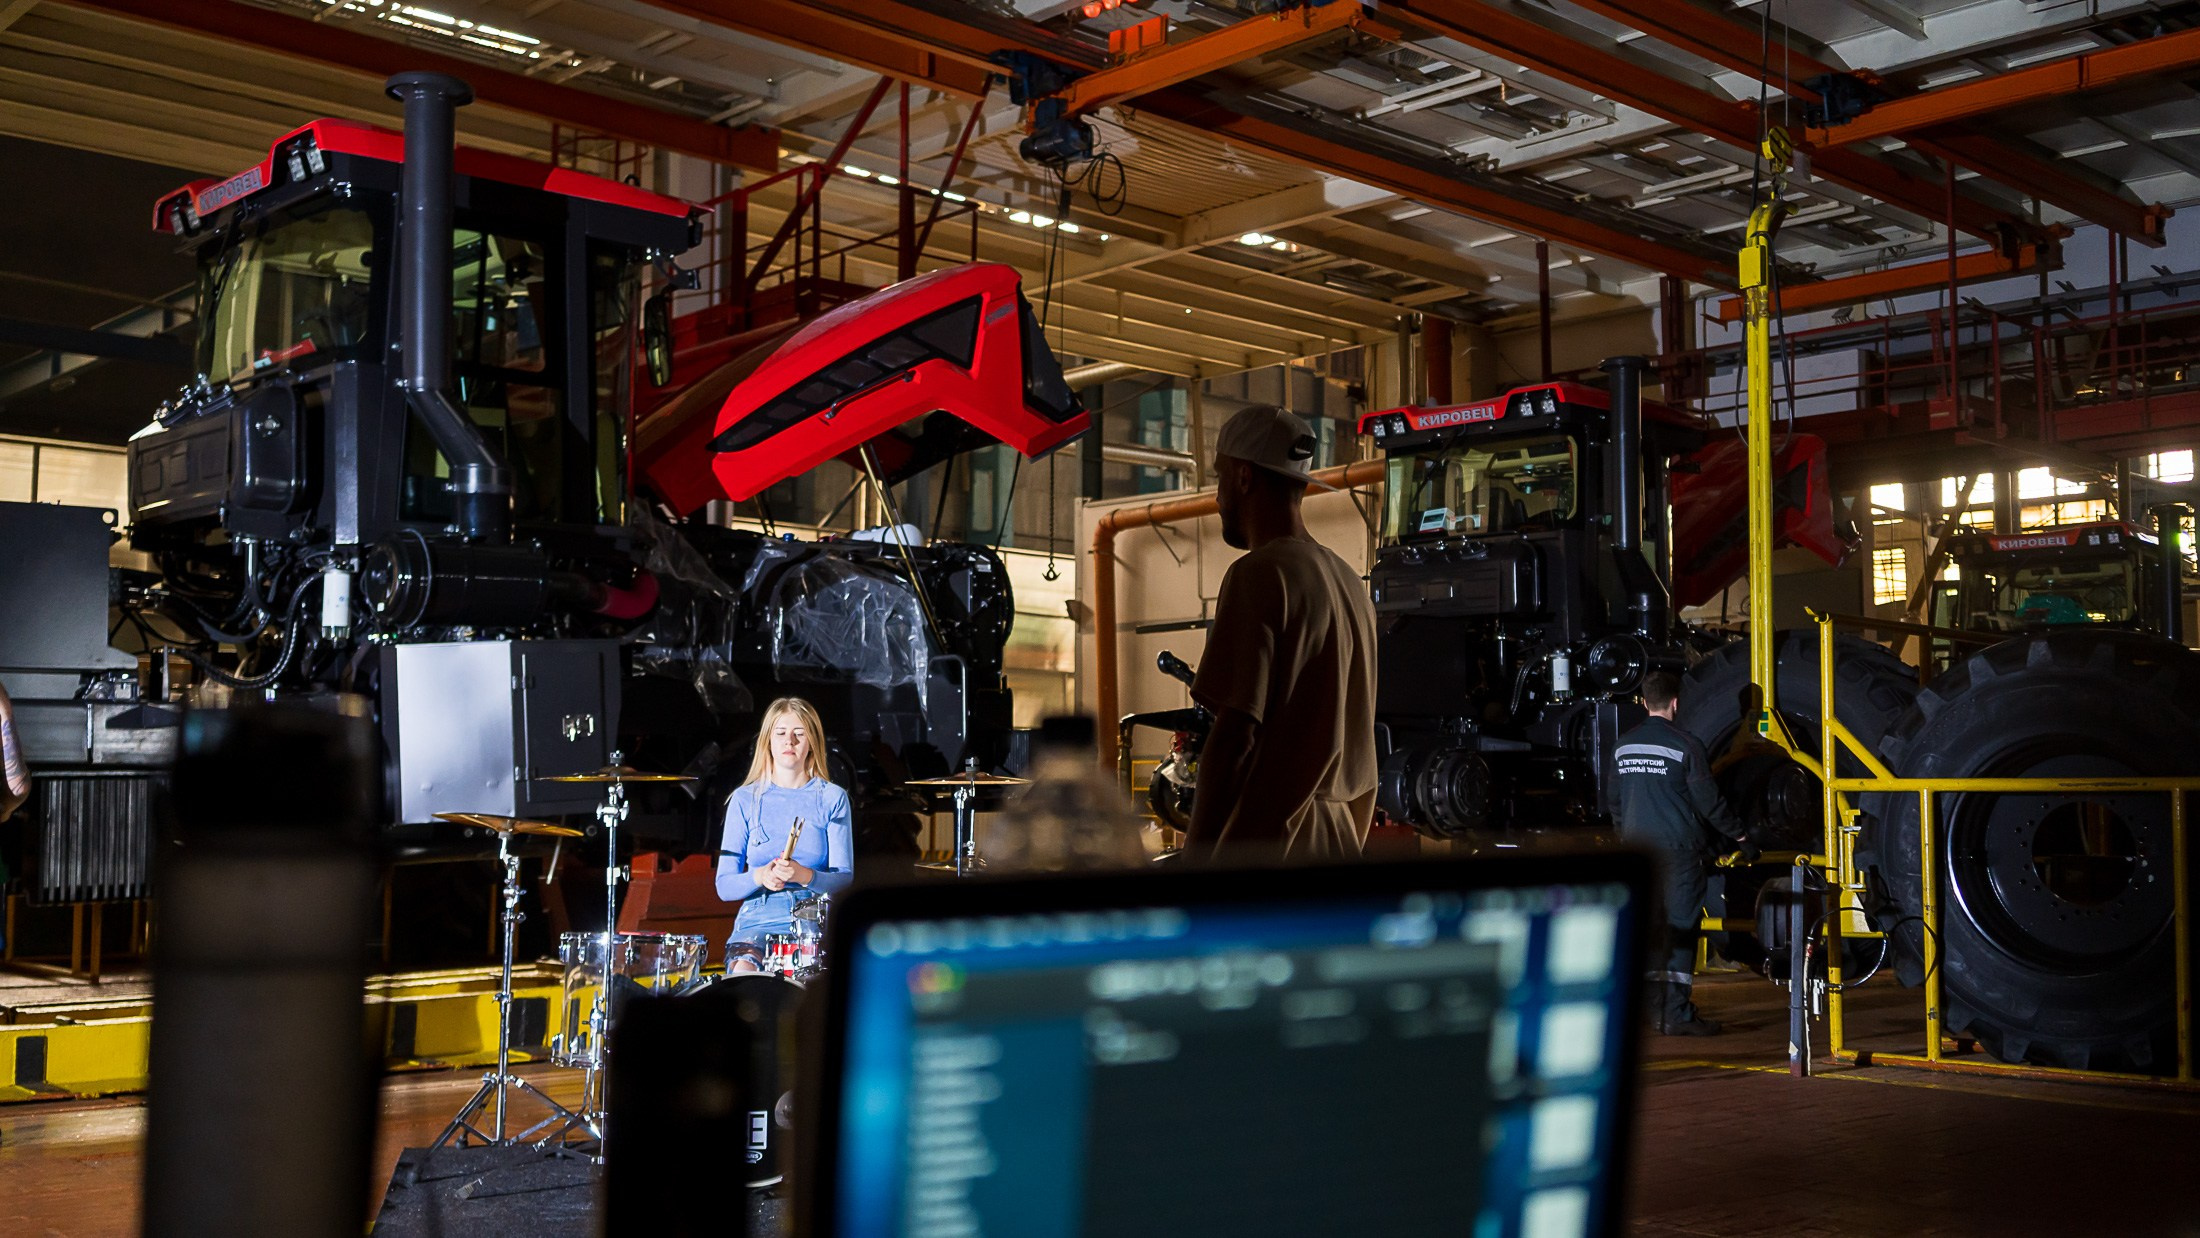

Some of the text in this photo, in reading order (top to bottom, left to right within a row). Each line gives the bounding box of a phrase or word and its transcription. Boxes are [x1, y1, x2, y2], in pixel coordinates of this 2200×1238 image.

[199, 167, 262, 211] КИРОВЕЦ
[1418, 405, 1496, 428] КИРОВЕЦ
[1998, 535, 2068, 550] КИРОВЕЦ
